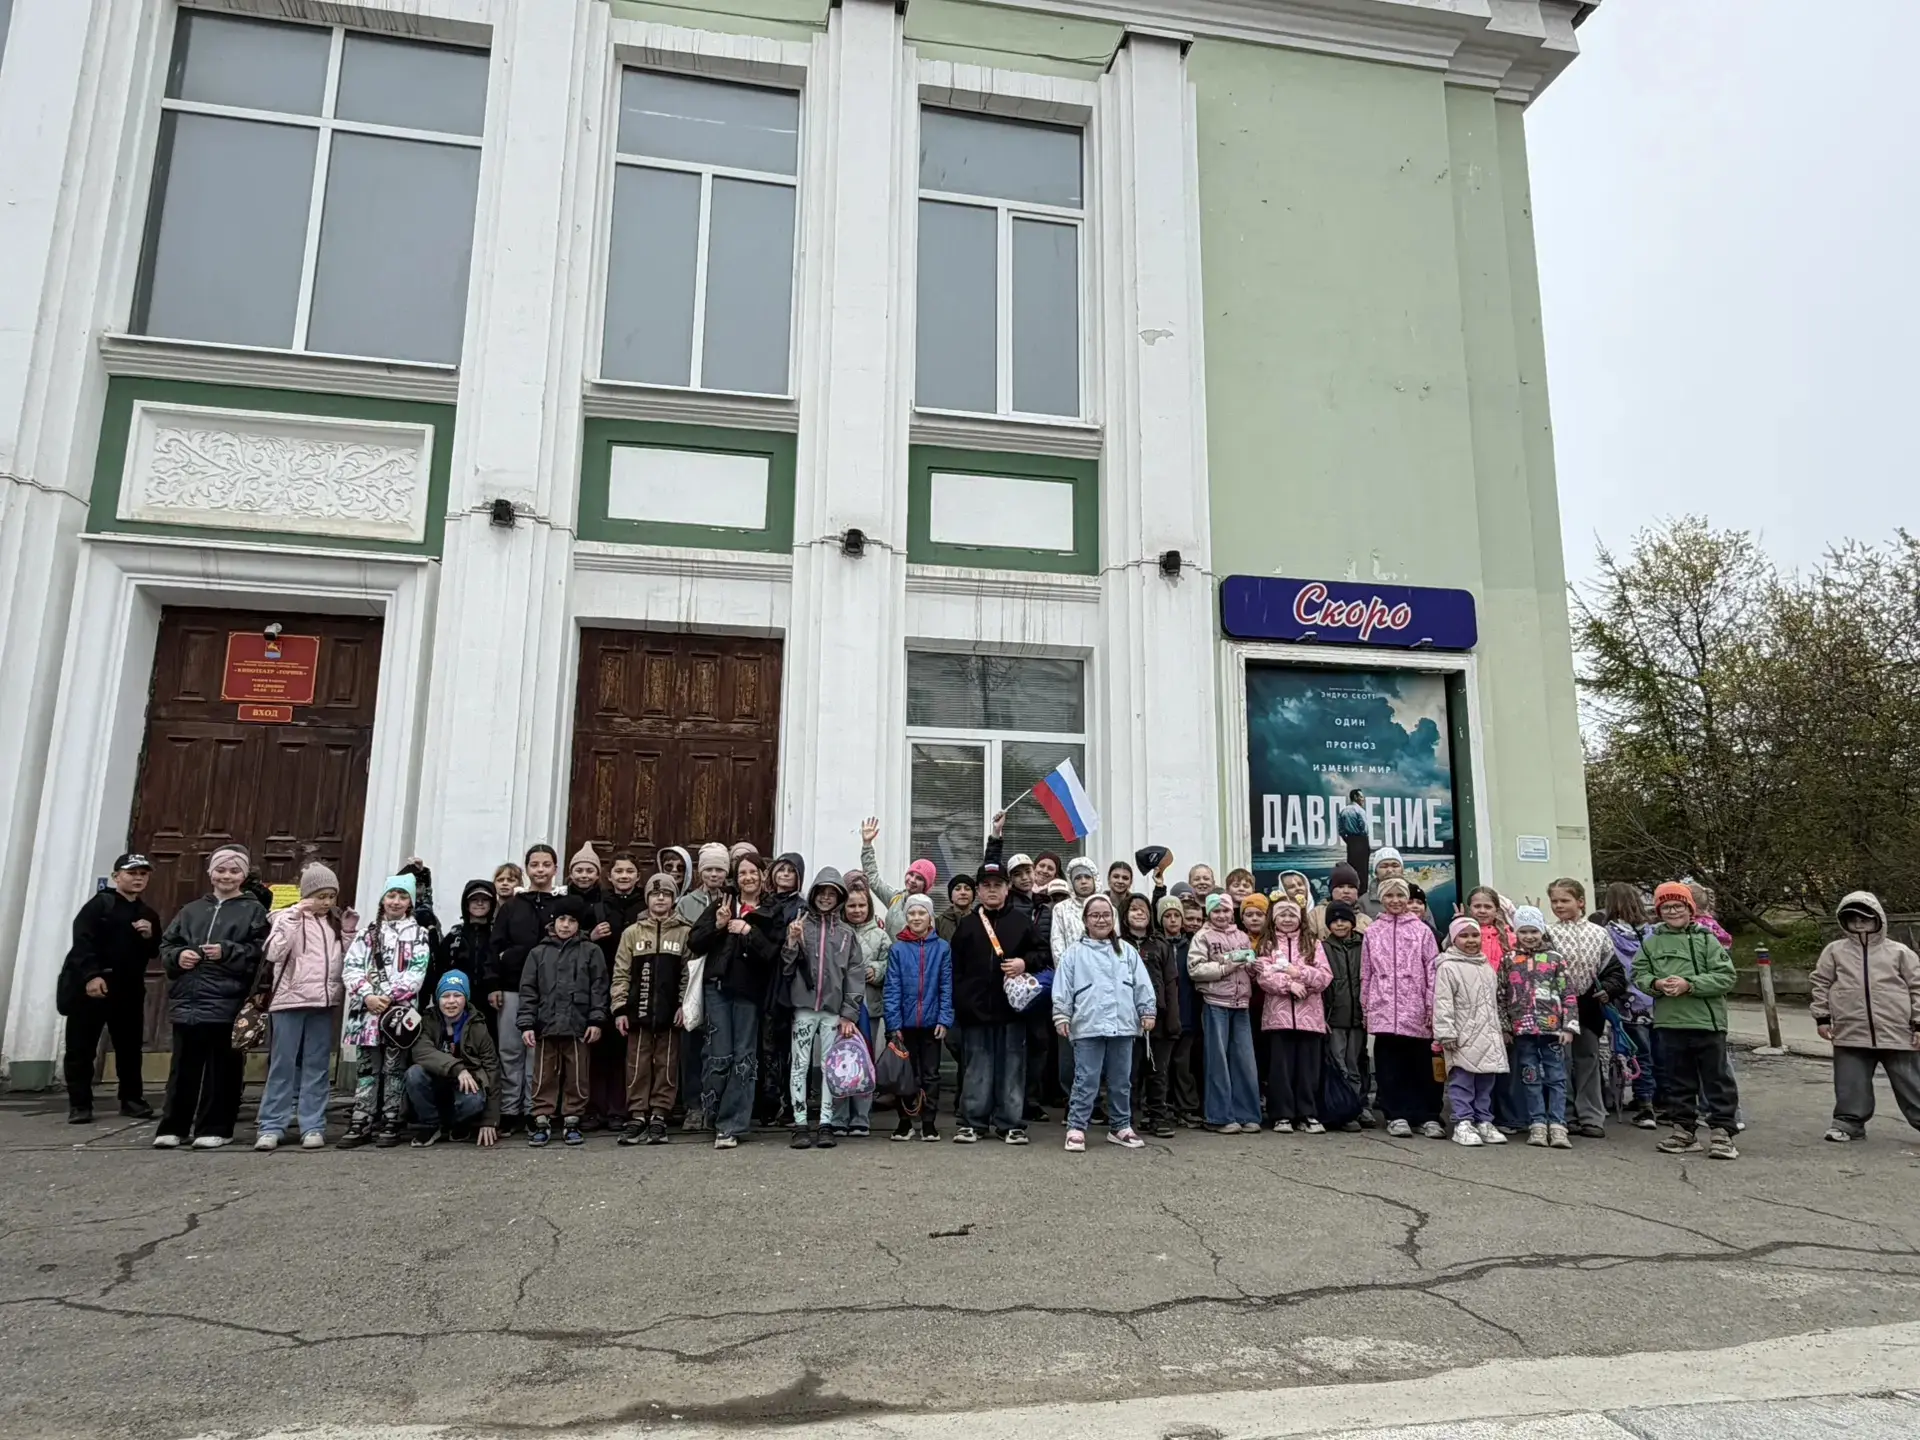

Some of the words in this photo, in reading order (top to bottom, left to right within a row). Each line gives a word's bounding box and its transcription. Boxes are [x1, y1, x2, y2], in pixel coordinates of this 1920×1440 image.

[1293, 582, 1411, 641] Скоро
[1321, 691, 1349, 699] ЭНДРЮ
[1351, 692, 1376, 700] СКОТТ
[252, 709, 278, 717] ВХОД
[1335, 718, 1365, 727] ОДИН
[1325, 741, 1376, 750] ПРОГНОЗ
[1312, 764, 1364, 773] ИЗМЕНИТ
[1368, 765, 1391, 774] МИР
